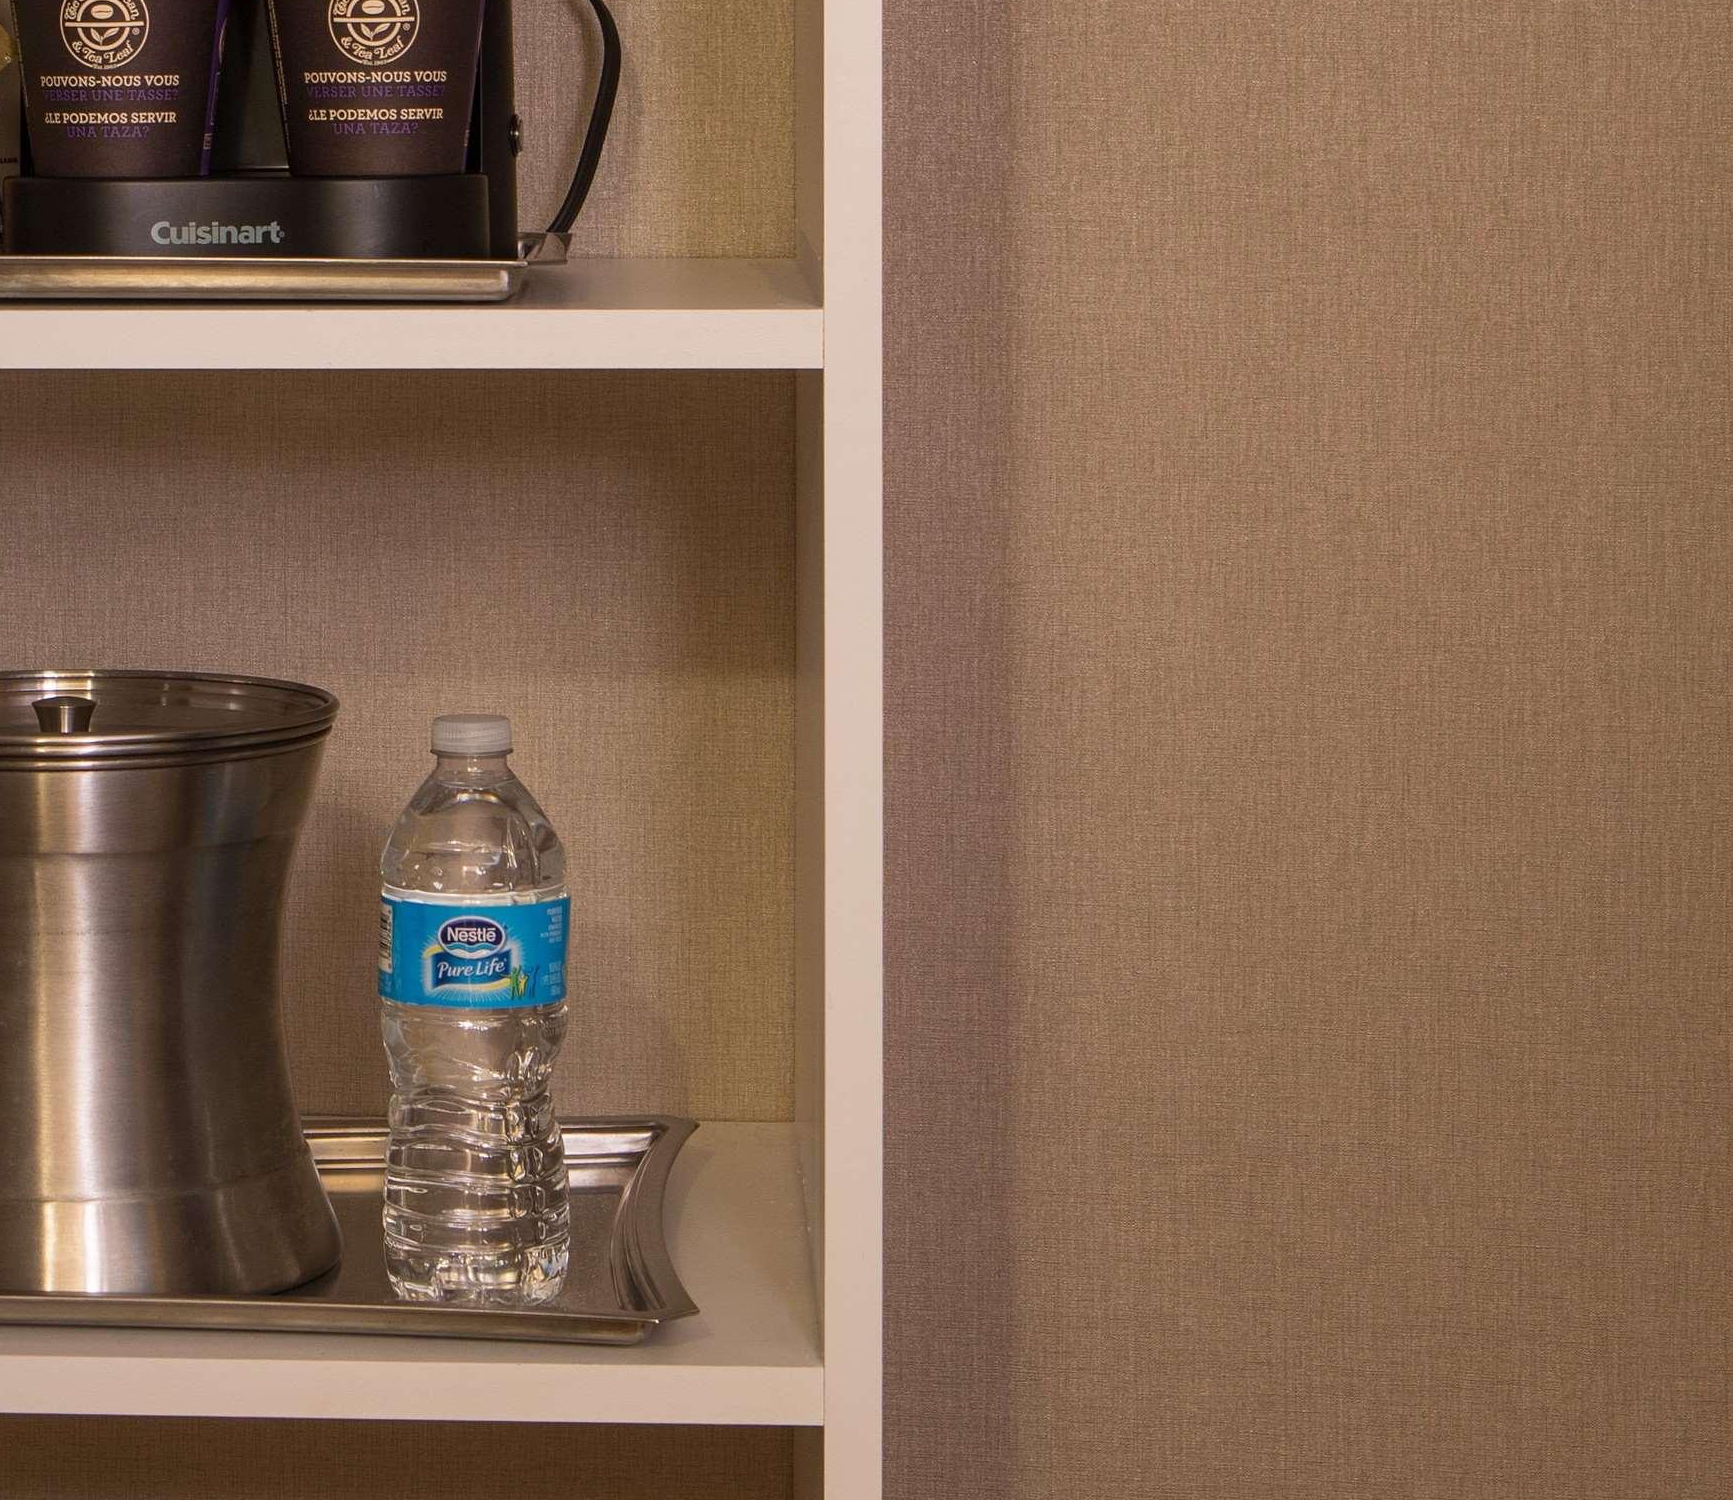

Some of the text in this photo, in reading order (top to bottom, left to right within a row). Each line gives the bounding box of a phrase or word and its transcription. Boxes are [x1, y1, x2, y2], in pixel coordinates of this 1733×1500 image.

[72, 40, 135, 63] & Tea Leaf
[341, 35, 405, 60] & Tea Leaf
[40, 74, 179, 87] POUVONS-NOUS VOUS
[304, 71, 447, 84] POUVONS-NOUS VOUS
[43, 89, 179, 101] VERSER UNE TASSE?
[307, 86, 356, 98] VERSER
[361, 86, 393, 97] UNE
[45, 112, 177, 124] ¿LE PODEMOS SERVIR
[308, 108, 443, 121] ¿LE PODEMOS SERVIR
[67, 125, 150, 138] UNA TAZA?
[333, 122, 418, 135] UNA TAZA?
[151, 221, 280, 244] Cuisinart
[437, 958, 505, 978] Pure Life
